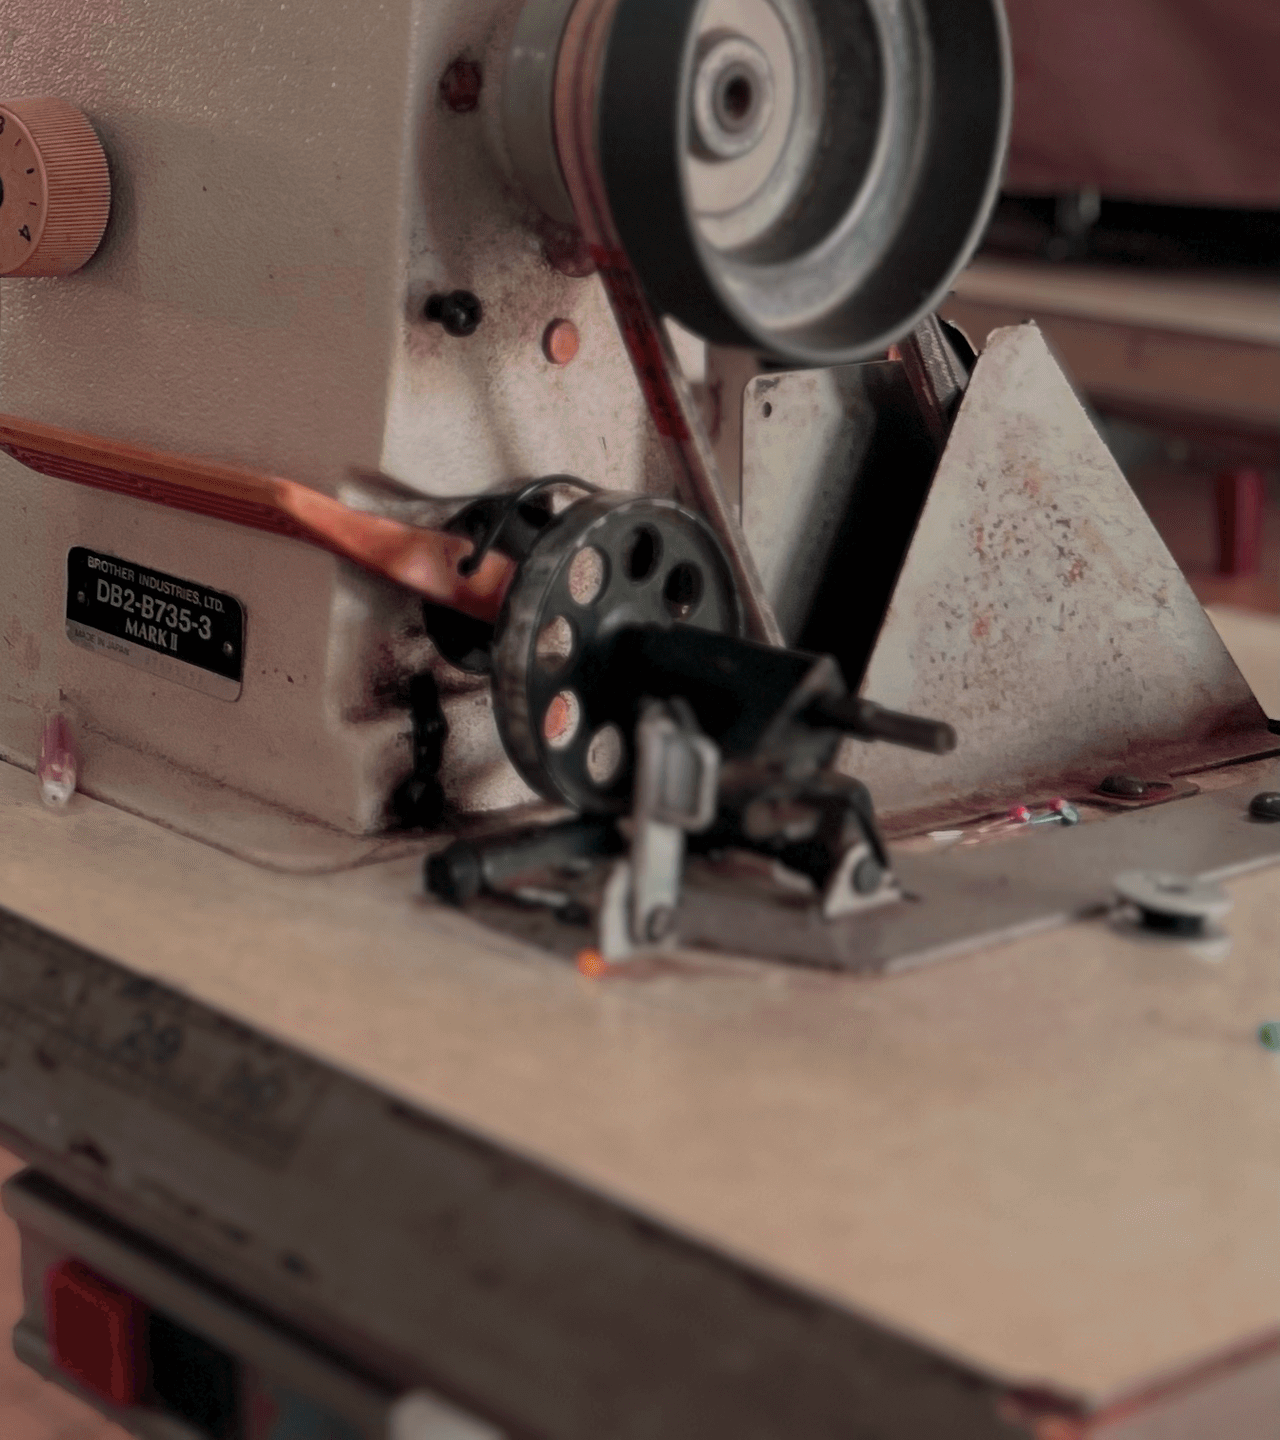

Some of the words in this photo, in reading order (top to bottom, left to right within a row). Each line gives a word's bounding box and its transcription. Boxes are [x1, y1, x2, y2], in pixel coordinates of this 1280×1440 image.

[17, 224, 32, 242] 4
[87, 555, 135, 582] BROTHER
[139, 573, 202, 606] INDUSTRIES,
[204, 595, 225, 613] LTD.
[96, 578, 211, 640] DB2-B735-3
[124, 617, 167, 648] MARK
